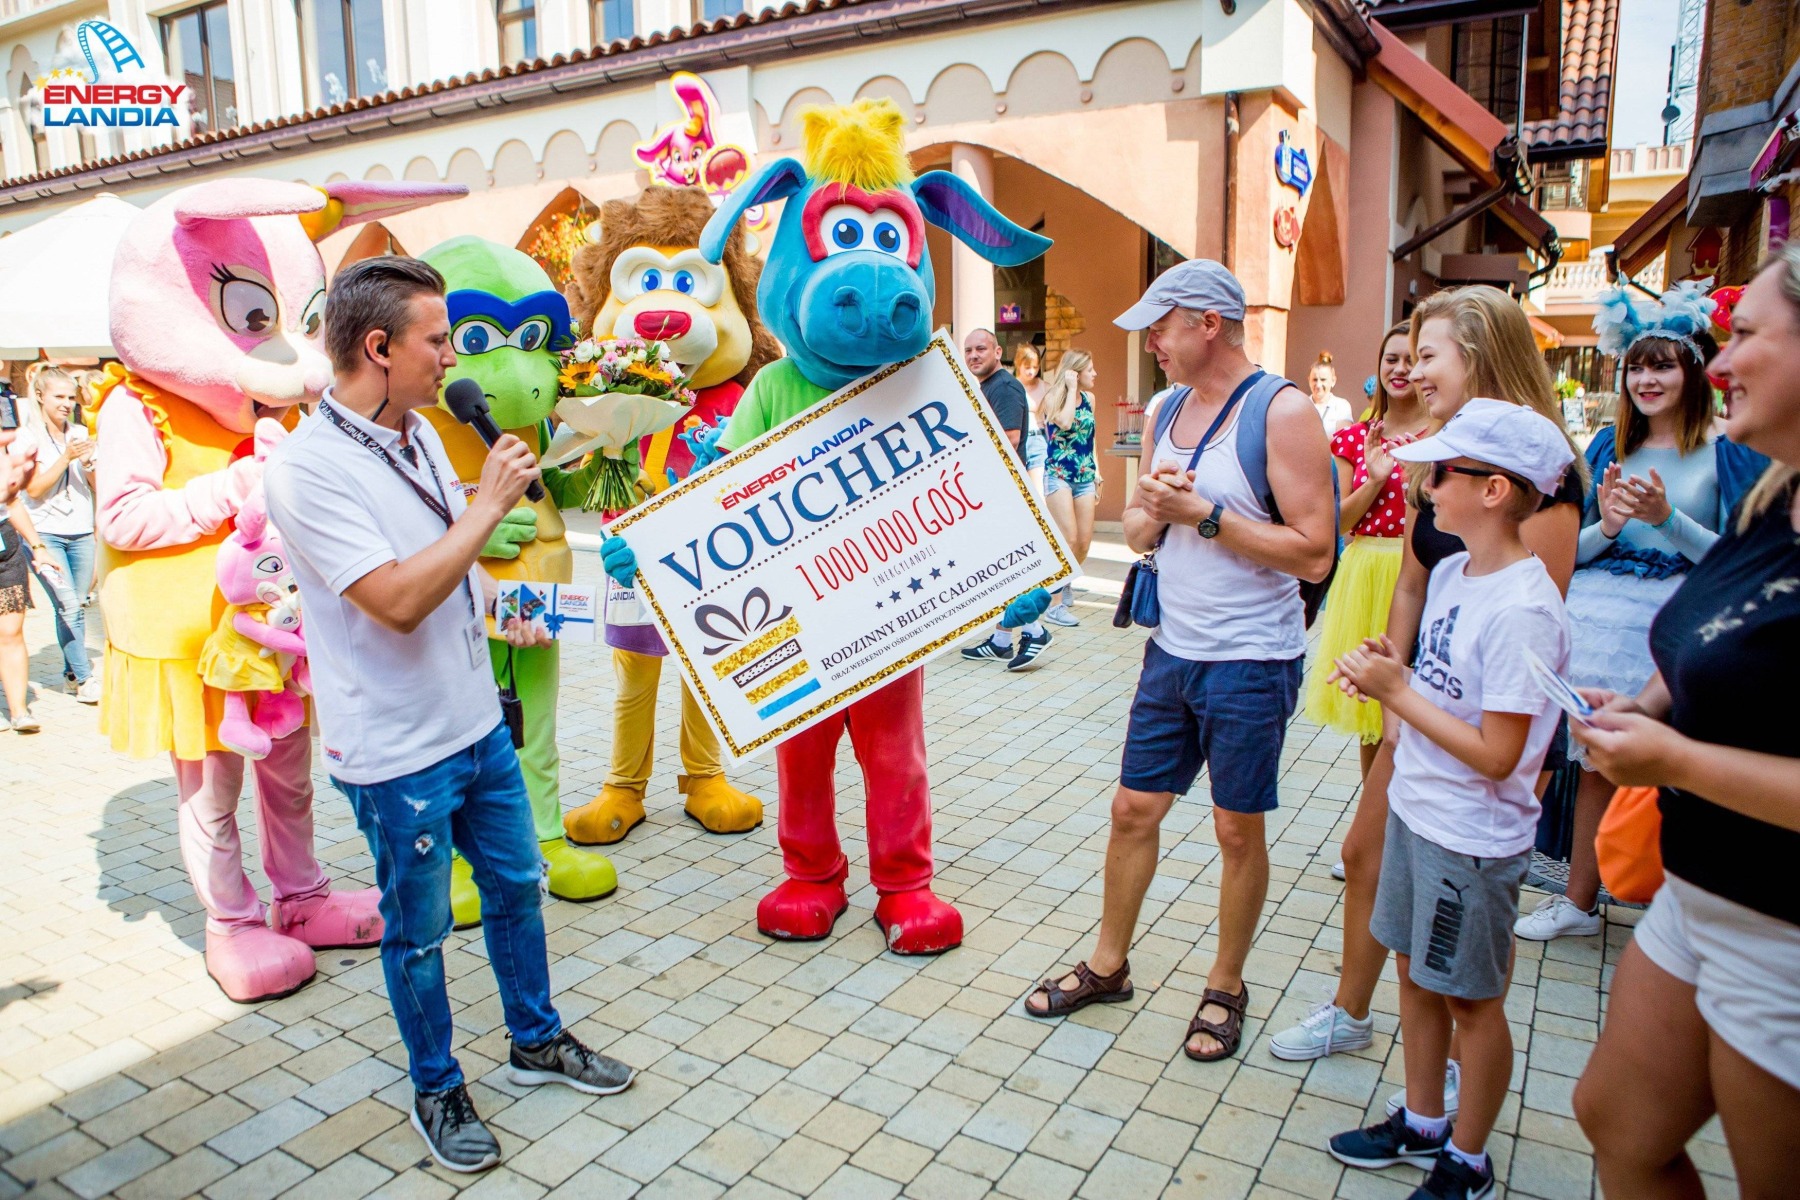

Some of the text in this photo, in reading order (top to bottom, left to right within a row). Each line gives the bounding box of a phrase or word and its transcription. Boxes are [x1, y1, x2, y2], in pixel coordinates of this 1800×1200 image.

[658, 401, 969, 591] VOUCHER
[912, 461, 983, 535] GOŚĆ
[610, 591, 636, 601] LANDIA
[873, 544, 937, 587] ENERGYLANDII
[820, 541, 1037, 671] RODZINNY BILET CAŁOROCZNY
[831, 559, 1042, 682] ORAZ WEEKEND W OŚRODKU WYPOCZYNKOWYM WESTERN CAMP
[1424, 897, 1465, 976] PUMA
